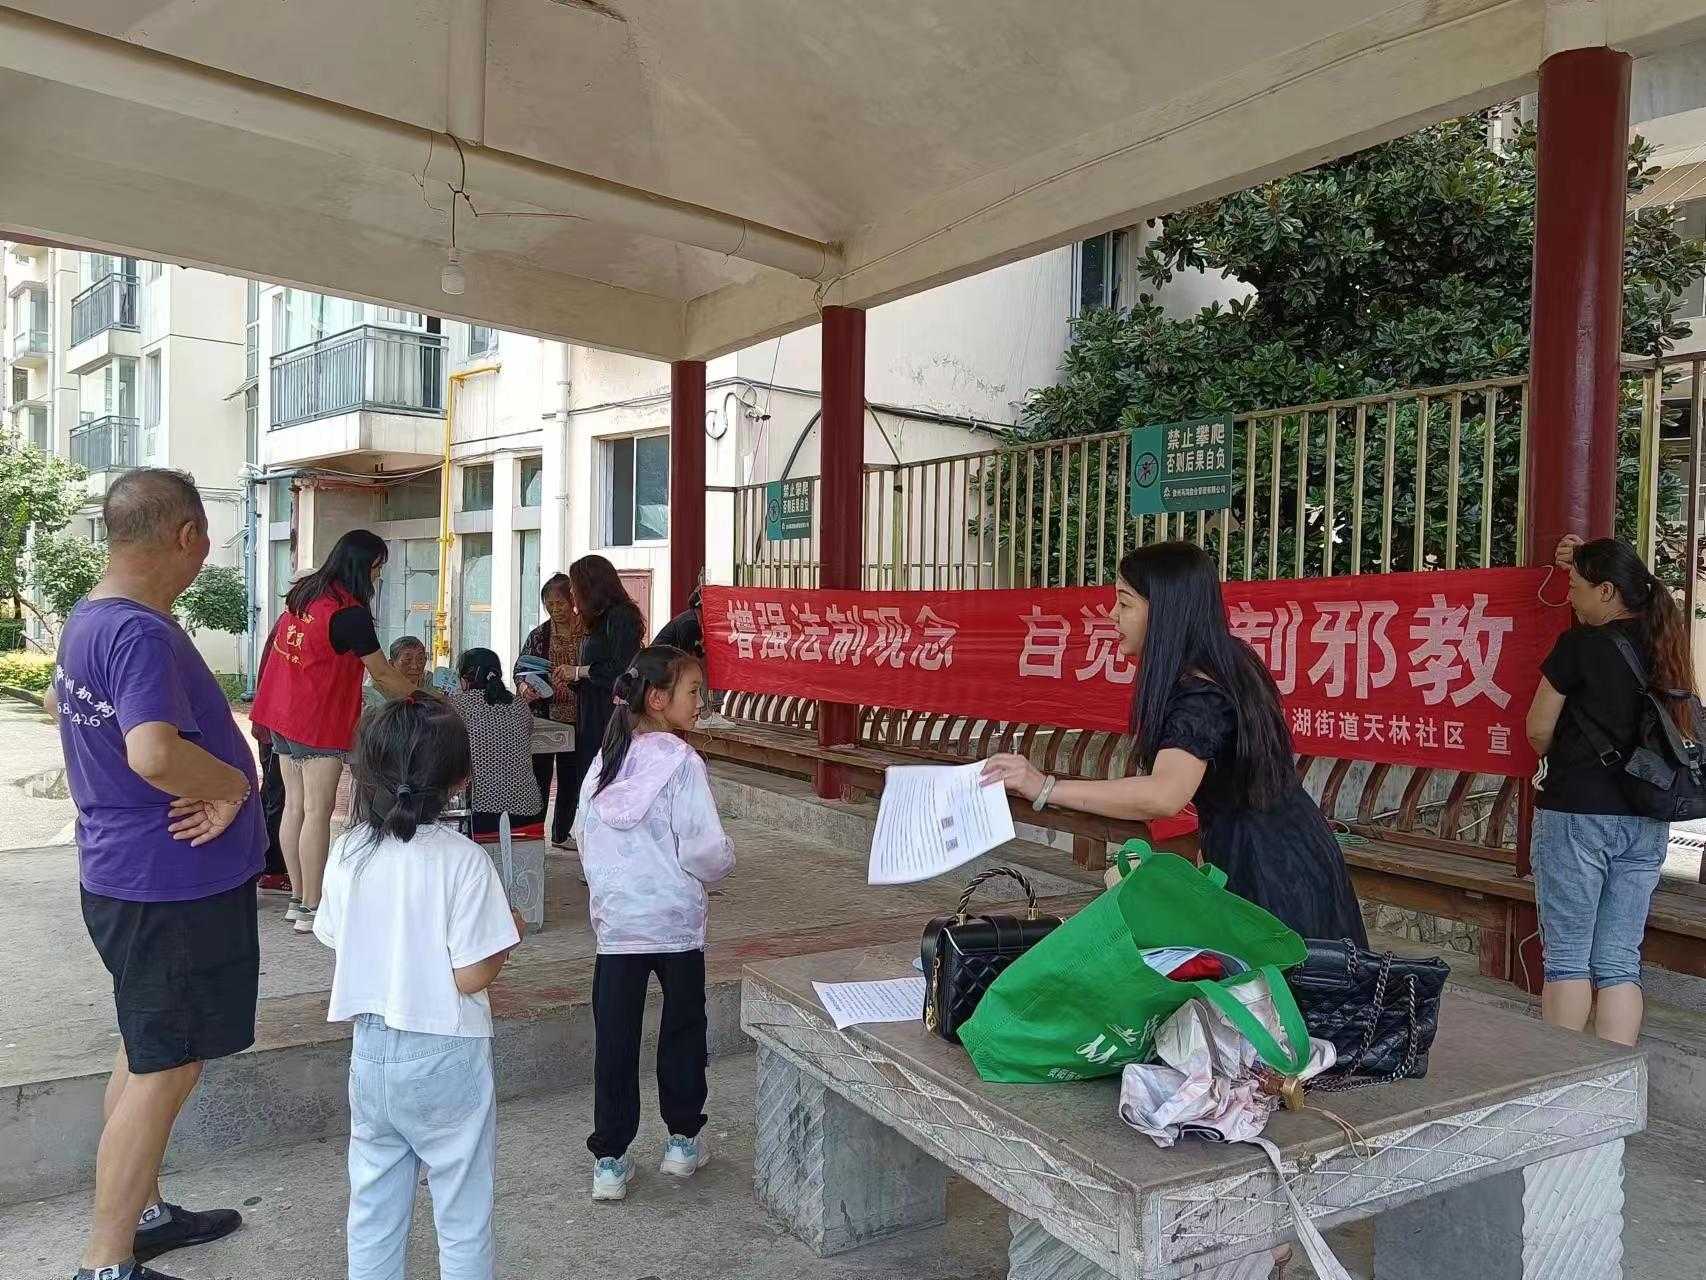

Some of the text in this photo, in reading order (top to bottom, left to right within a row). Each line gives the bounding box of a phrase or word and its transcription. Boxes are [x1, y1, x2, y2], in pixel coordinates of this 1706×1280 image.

[1167, 423, 1225, 450] 禁止攀爬
[1167, 447, 1225, 474] 否则后果自负
[727, 593, 1513, 710] 增强法制观念 自觉制邪教
[1284, 707, 1512, 756] 湖街道天林社区 宣
